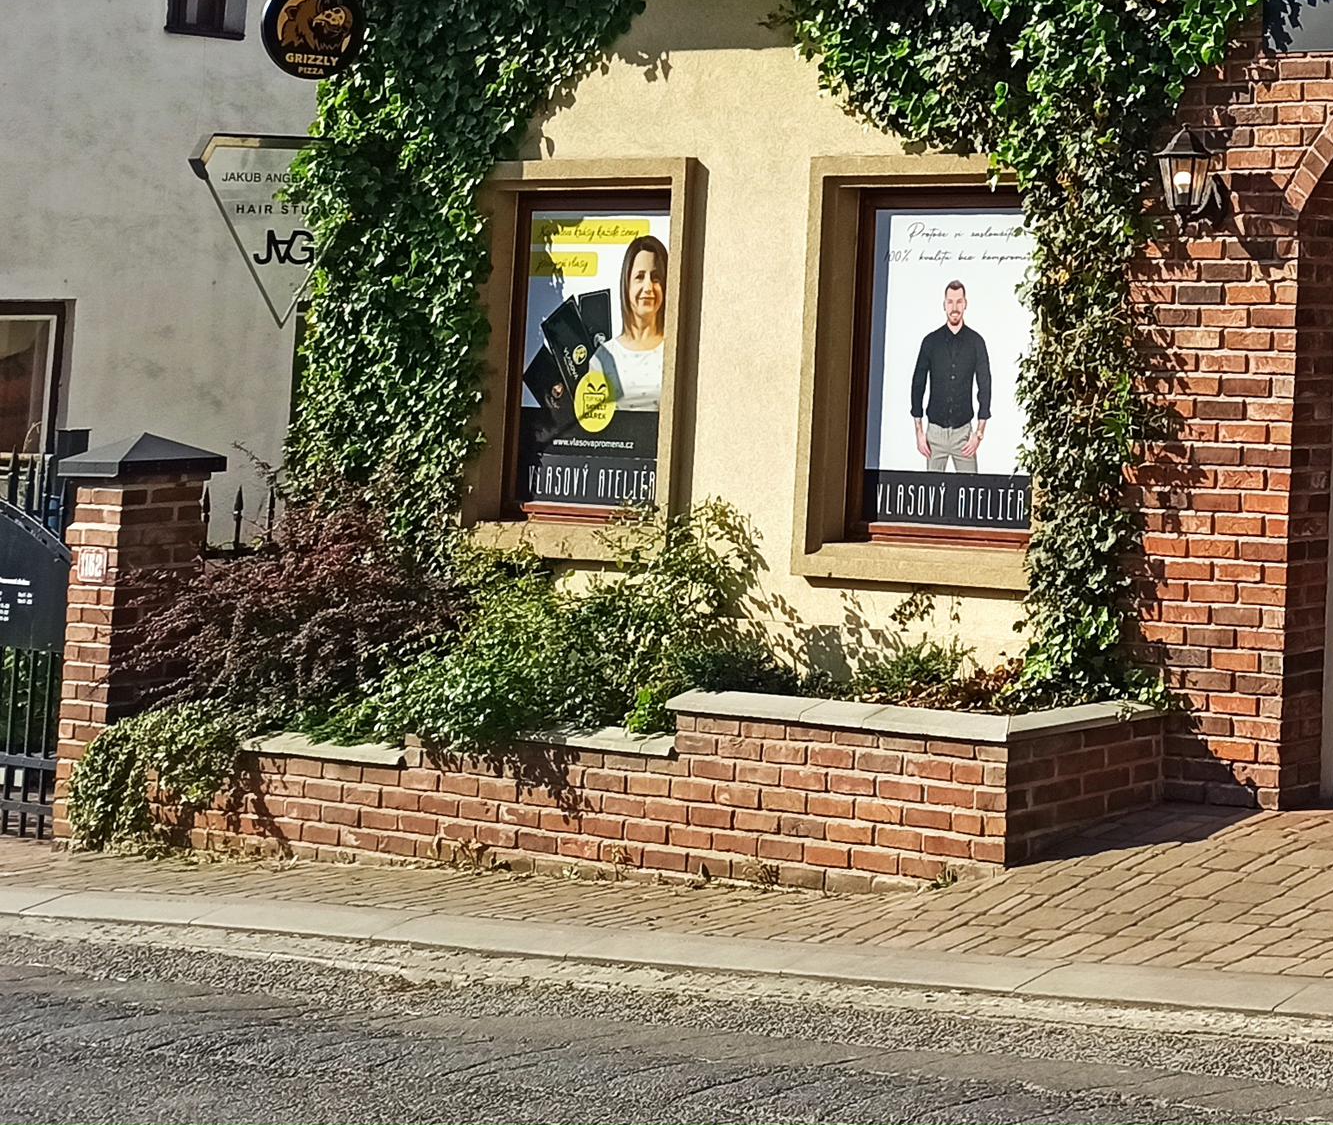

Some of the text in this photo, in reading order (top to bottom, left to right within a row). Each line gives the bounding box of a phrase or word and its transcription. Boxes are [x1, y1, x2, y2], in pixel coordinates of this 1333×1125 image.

[285, 52, 339, 67] GRIZZLY
[298, 66, 325, 75] PIZZA
[222, 172, 262, 183] JAKUB
[236, 204, 273, 214] HAIR
[553, 437, 634, 449] www.vlasovapromena.cz
[528, 463, 656, 501] VLASOVÝ ATELIÉR
[877, 482, 1024, 521] VLASOVÝ ATELIÉR
